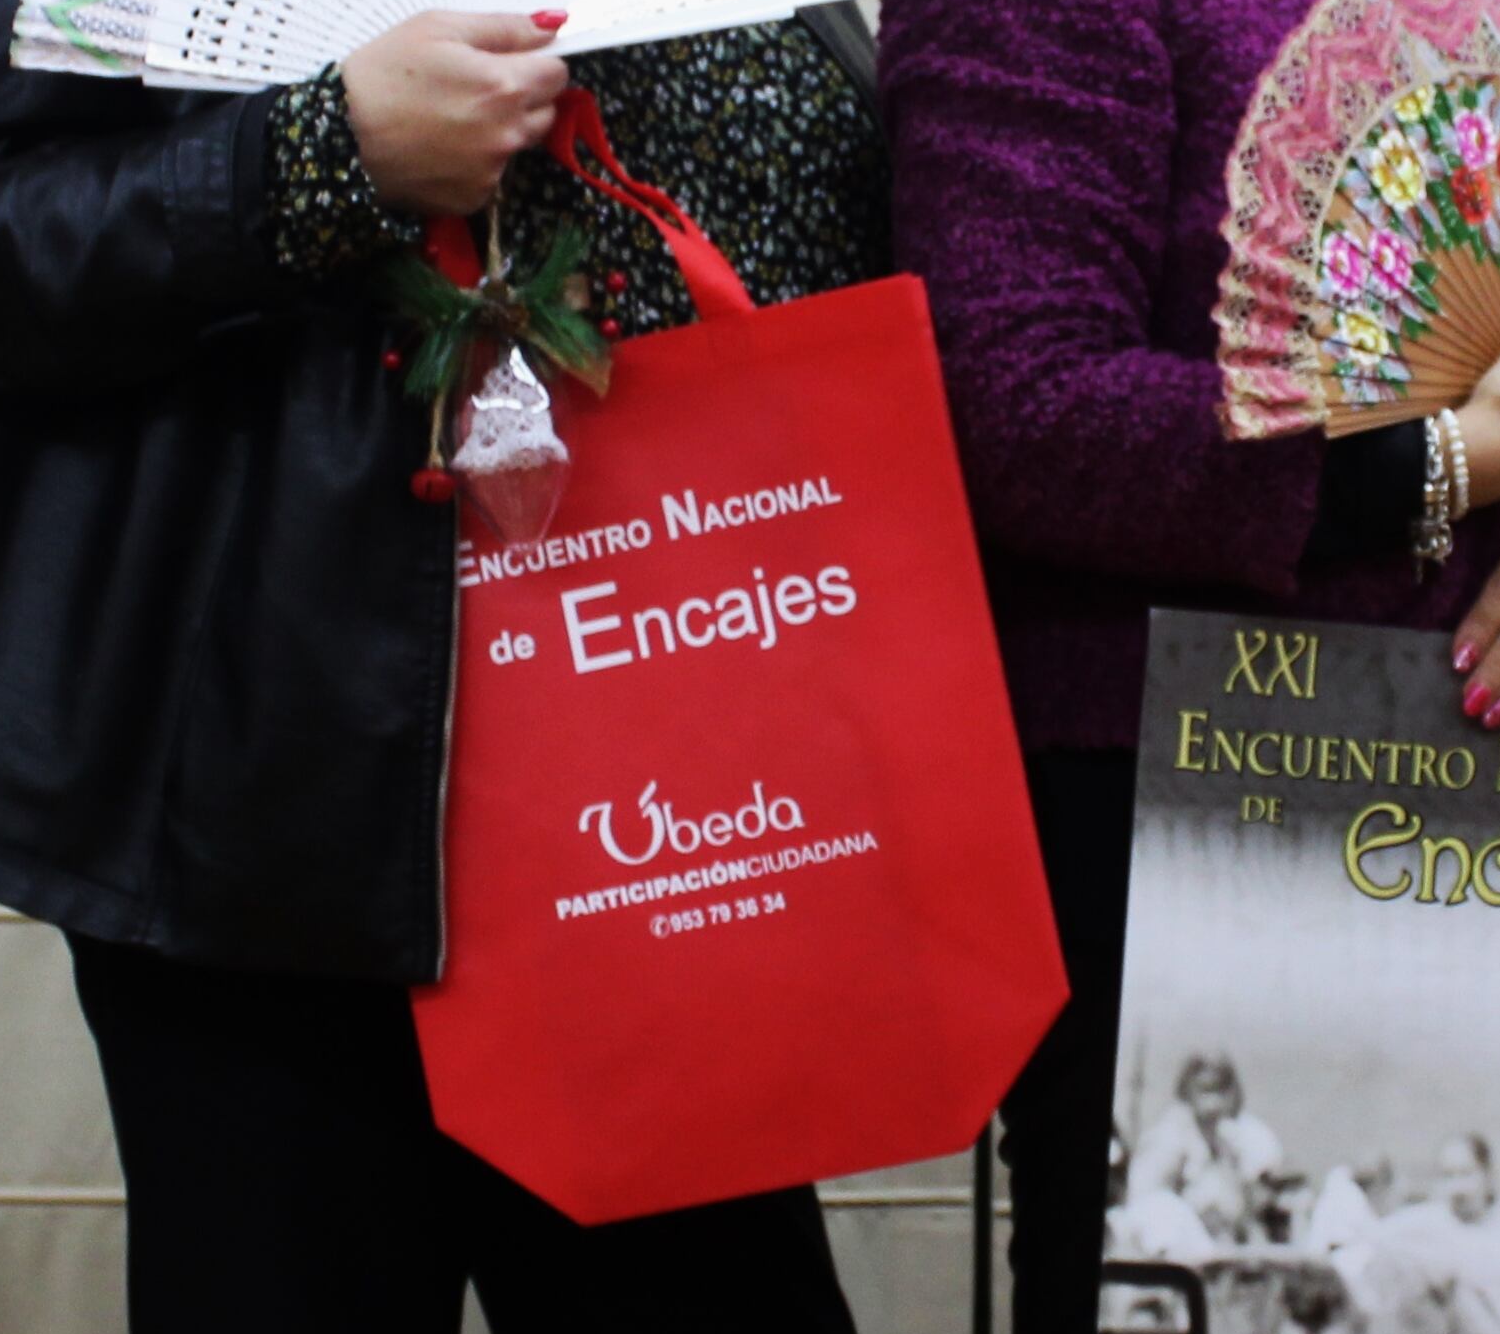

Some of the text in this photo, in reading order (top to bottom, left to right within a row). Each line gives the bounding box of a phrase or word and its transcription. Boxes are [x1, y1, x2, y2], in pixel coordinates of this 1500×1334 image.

[660, 475, 842, 541] NACIONAL
[489, 563, 857, 674] de Encajes
[1223, 629, 1320, 700] XXI
[1173, 709, 1476, 791] ENCUENTRO
[579, 780, 804, 866] Úbeda
[1239, 794, 1284, 824] DE
[763, 891, 786, 914] 34
